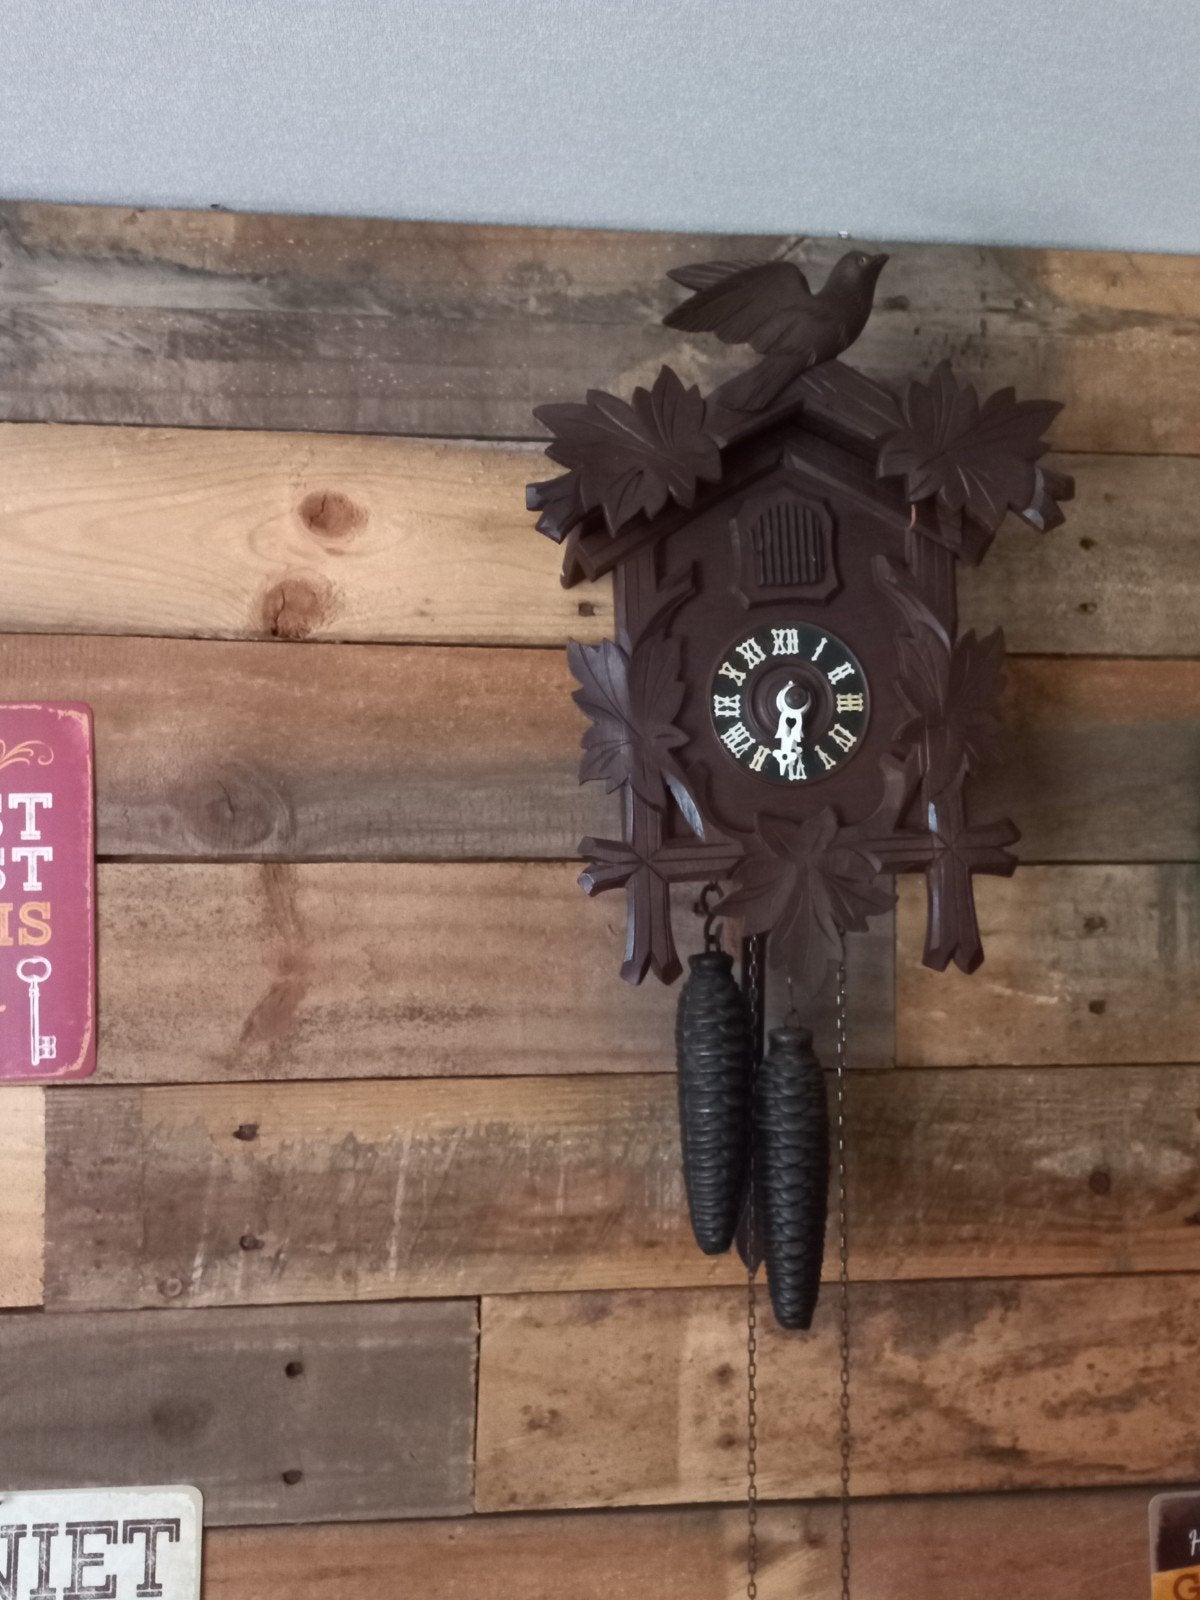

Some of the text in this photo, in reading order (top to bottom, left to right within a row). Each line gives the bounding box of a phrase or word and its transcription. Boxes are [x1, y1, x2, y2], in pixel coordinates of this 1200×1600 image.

[735, 637, 767, 669] XI
[771, 628, 799, 656] XII
[718, 661, 747, 687] X
[827, 661, 855, 685] II
[713, 694, 741, 718] IX
[836, 692, 864, 714] III
